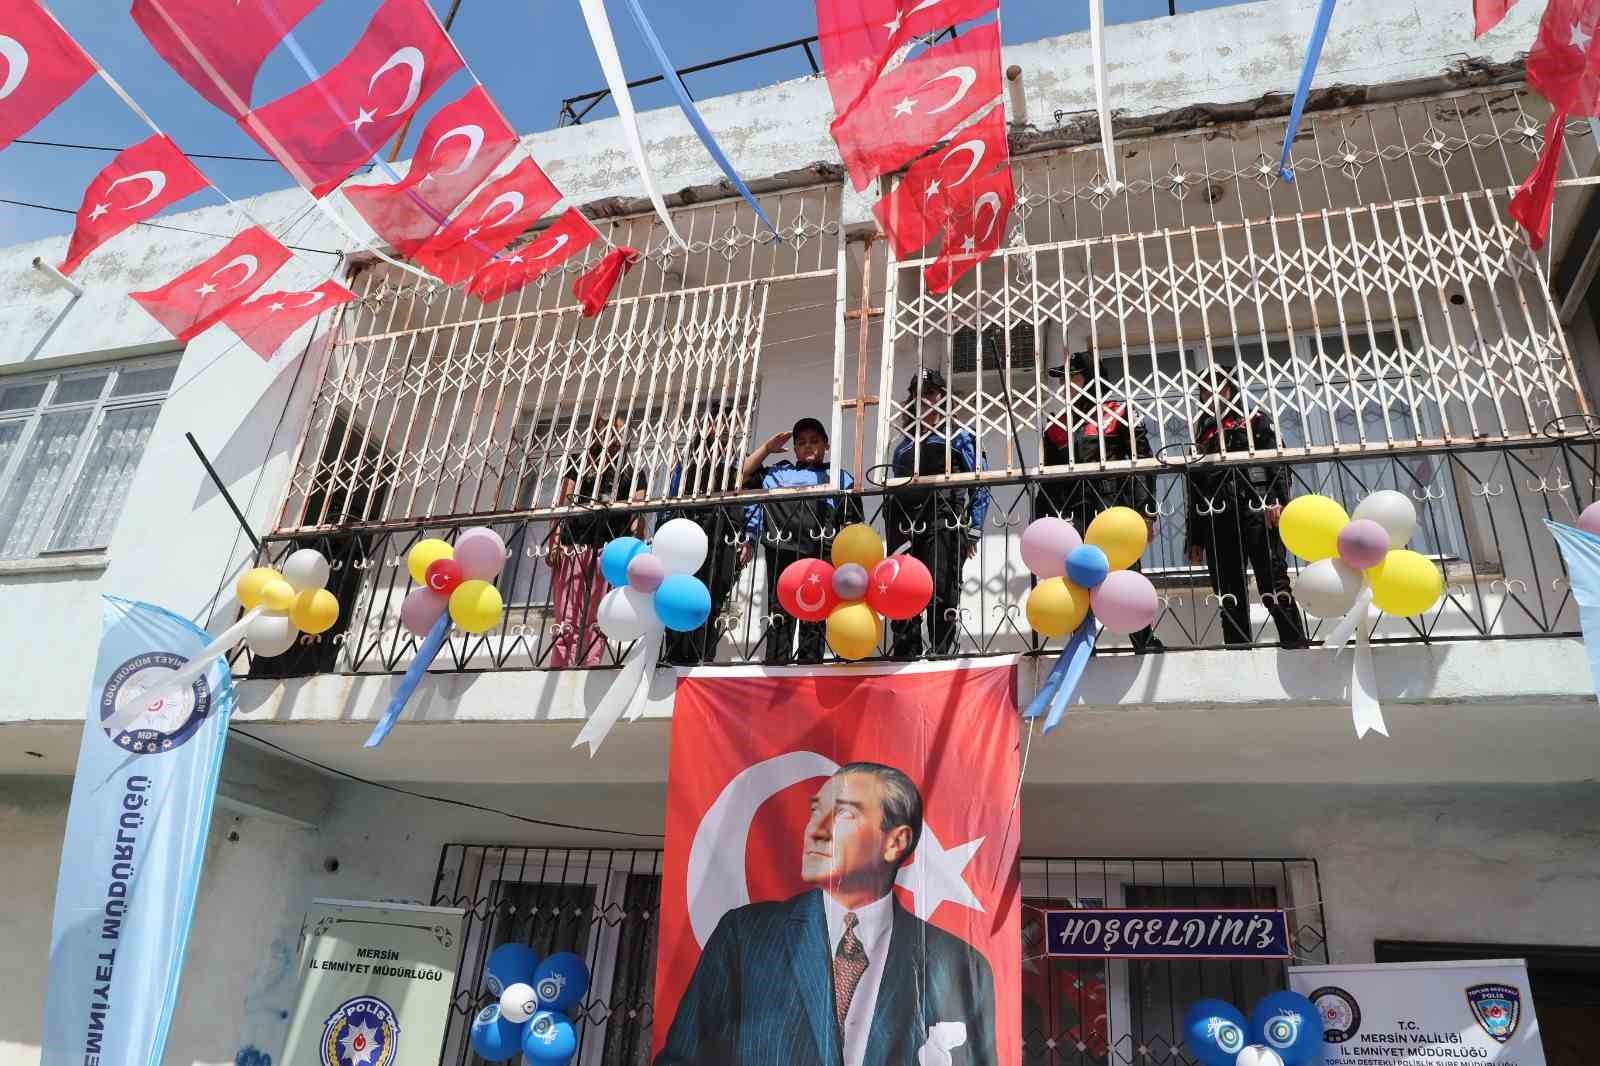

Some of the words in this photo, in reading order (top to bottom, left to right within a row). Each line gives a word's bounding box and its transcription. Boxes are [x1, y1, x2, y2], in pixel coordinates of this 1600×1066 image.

[1059, 914, 1275, 952] HOŞGELDİNİZ
[356, 948, 399, 960] MERSİN
[309, 959, 319, 969] İL
[321, 960, 369, 974] EMNİYET
[372, 965, 443, 982] MÜDÜRLÜĞÜ
[346, 1003, 386, 1020] POLİS
[1398, 1021, 1420, 1031] T.C.
[1361, 1033, 1407, 1043] MERSİN
[1410, 1031, 1463, 1043] VALİLİĞİ
[1340, 1045, 1351, 1056] İL
[1354, 1045, 1405, 1057] EMNİYET
[1408, 1046, 1488, 1058] MÜDÜRLÜĞÜ
